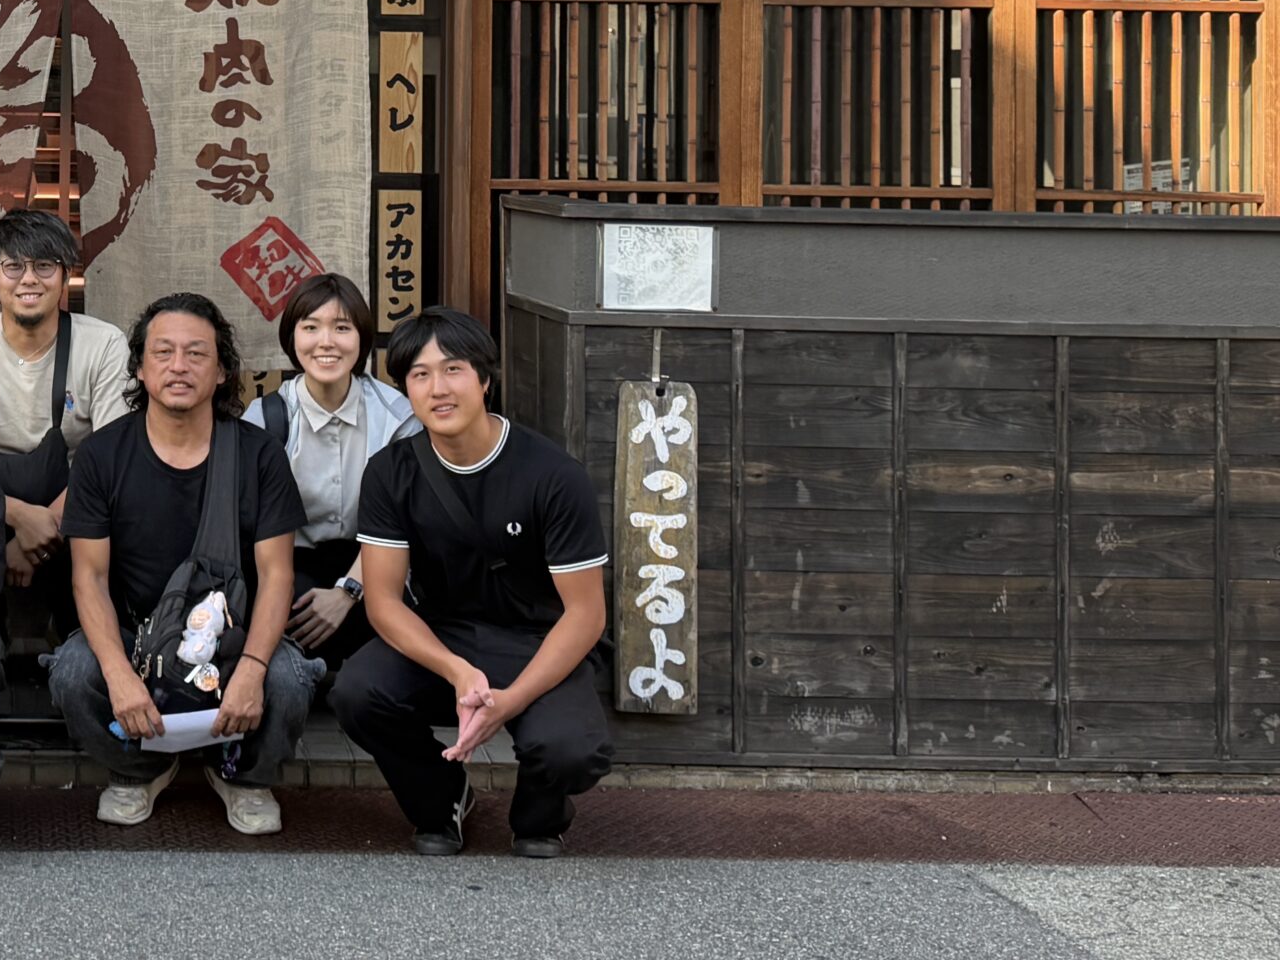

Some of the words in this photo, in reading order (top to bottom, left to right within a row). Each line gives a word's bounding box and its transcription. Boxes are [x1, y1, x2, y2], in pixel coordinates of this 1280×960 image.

[387, 73, 416, 132] ヘレ
[385, 202, 416, 322] アカセン
[628, 395, 696, 701] やってるよ
